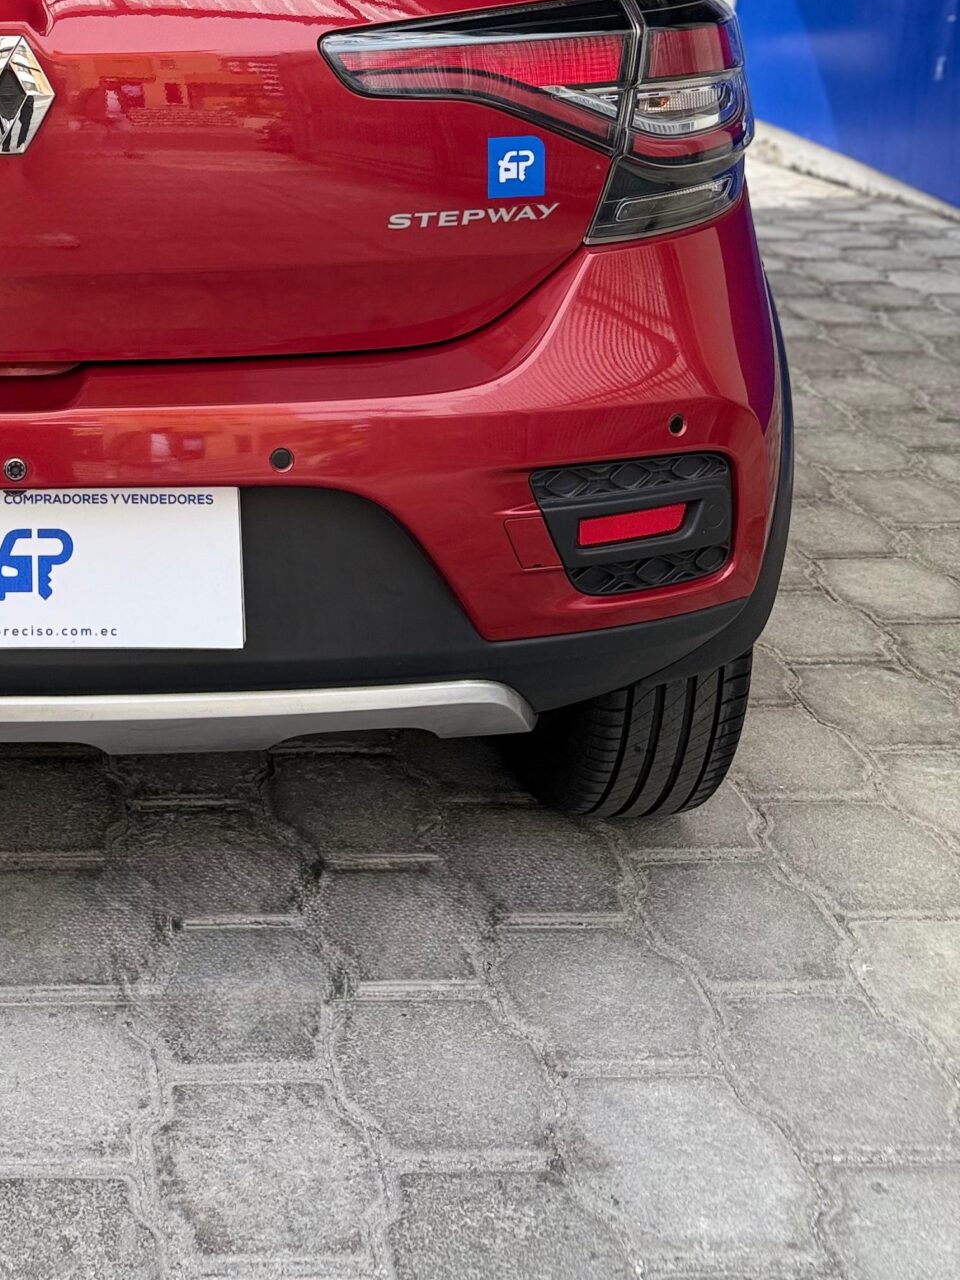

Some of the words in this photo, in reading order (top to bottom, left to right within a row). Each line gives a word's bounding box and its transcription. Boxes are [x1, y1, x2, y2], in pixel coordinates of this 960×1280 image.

[387, 202, 560, 230] STEPWAY
[3, 493, 109, 506] COMPRADORES
[110, 493, 120, 505] Y
[121, 493, 214, 505] VENDEDORES
